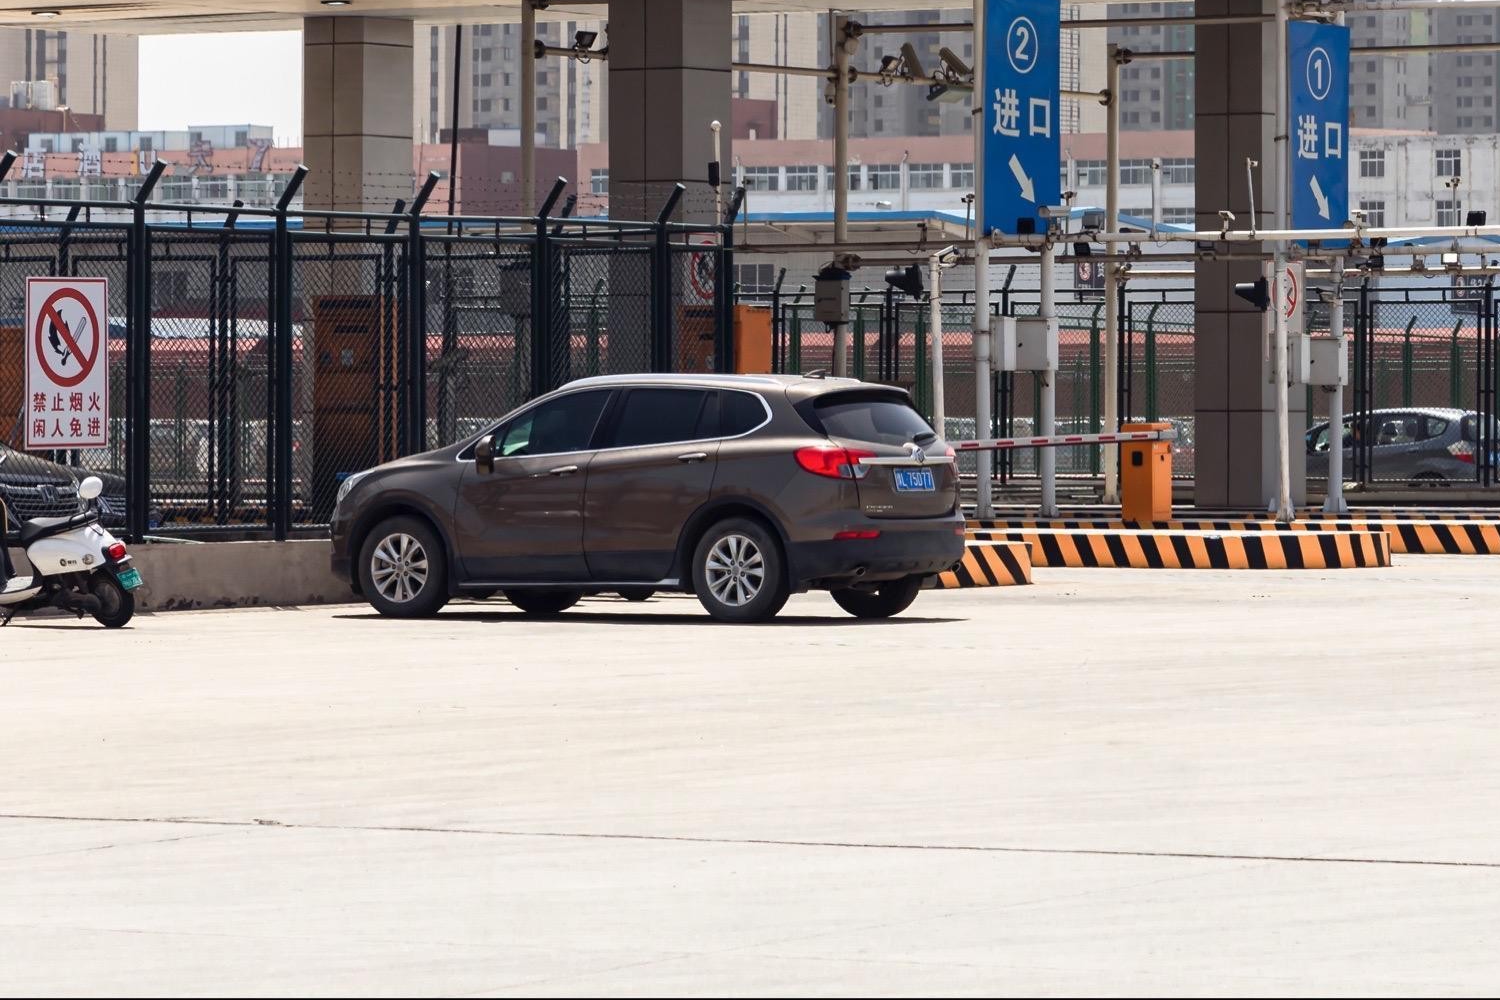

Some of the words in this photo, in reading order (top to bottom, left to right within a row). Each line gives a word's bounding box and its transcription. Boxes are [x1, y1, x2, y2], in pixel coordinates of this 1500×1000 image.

[993, 88, 1051, 138] 进口
[1297, 115, 1342, 159] 进口
[33, 392, 101, 412] 禁止烟火
[33, 417, 101, 438] 闲人免进
